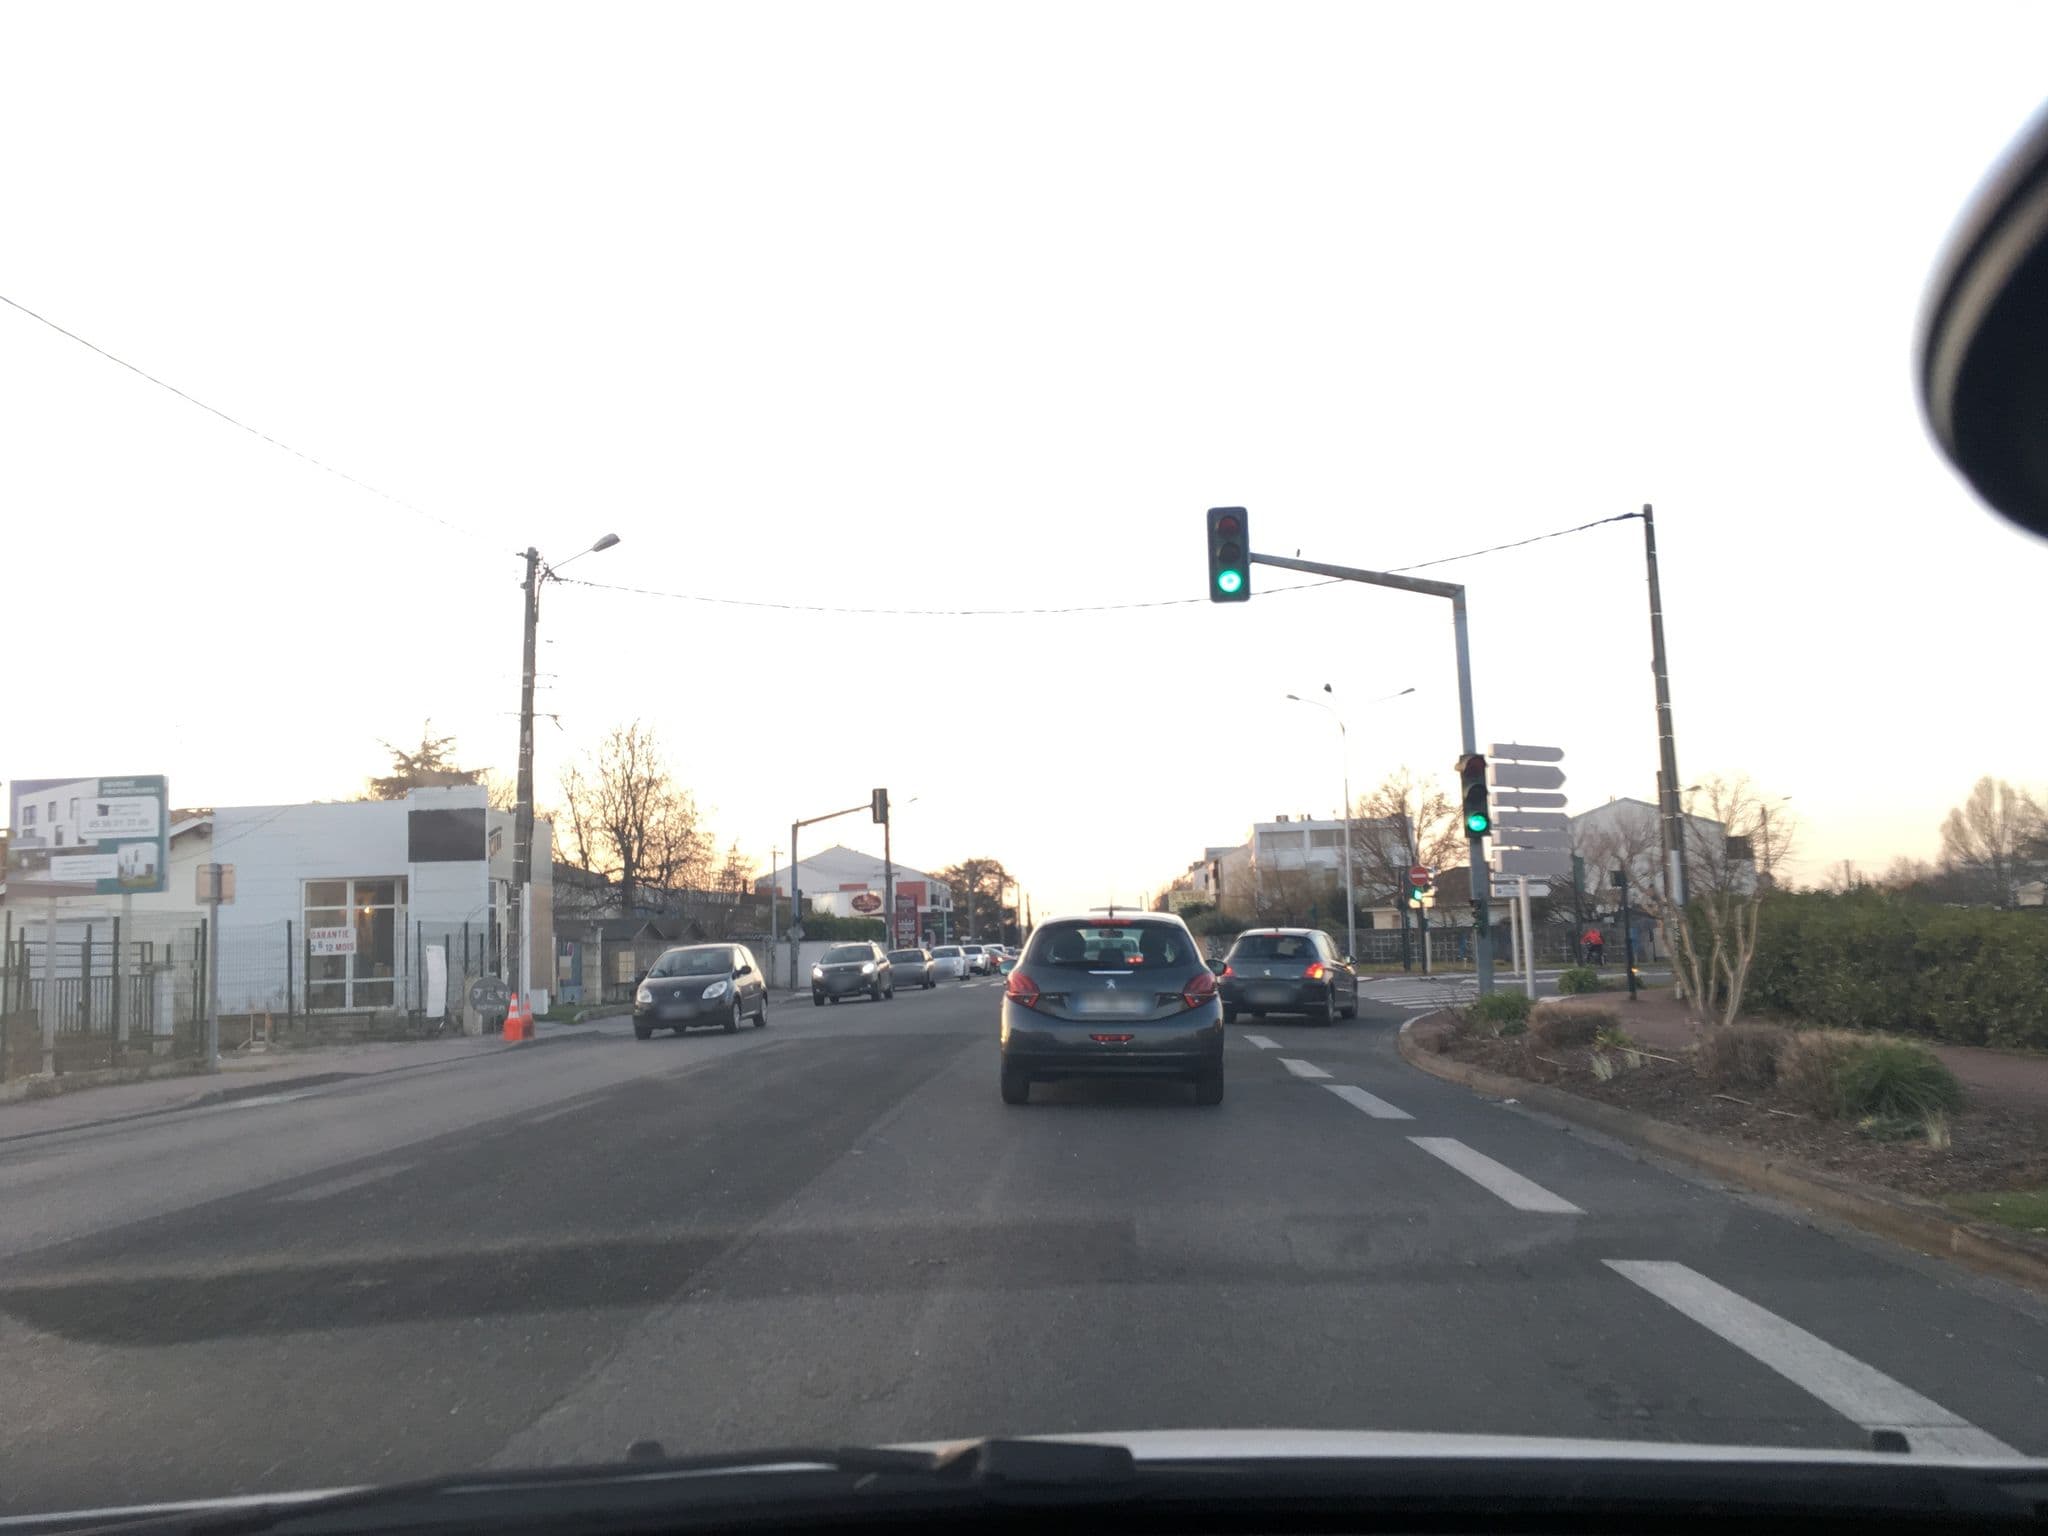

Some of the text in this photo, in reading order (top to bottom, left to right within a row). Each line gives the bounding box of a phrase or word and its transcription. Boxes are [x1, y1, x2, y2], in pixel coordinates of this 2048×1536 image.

[311, 930, 349, 940] GARANTIE
[325, 943, 334, 952] 12
[335, 942, 354, 951] MOIS
